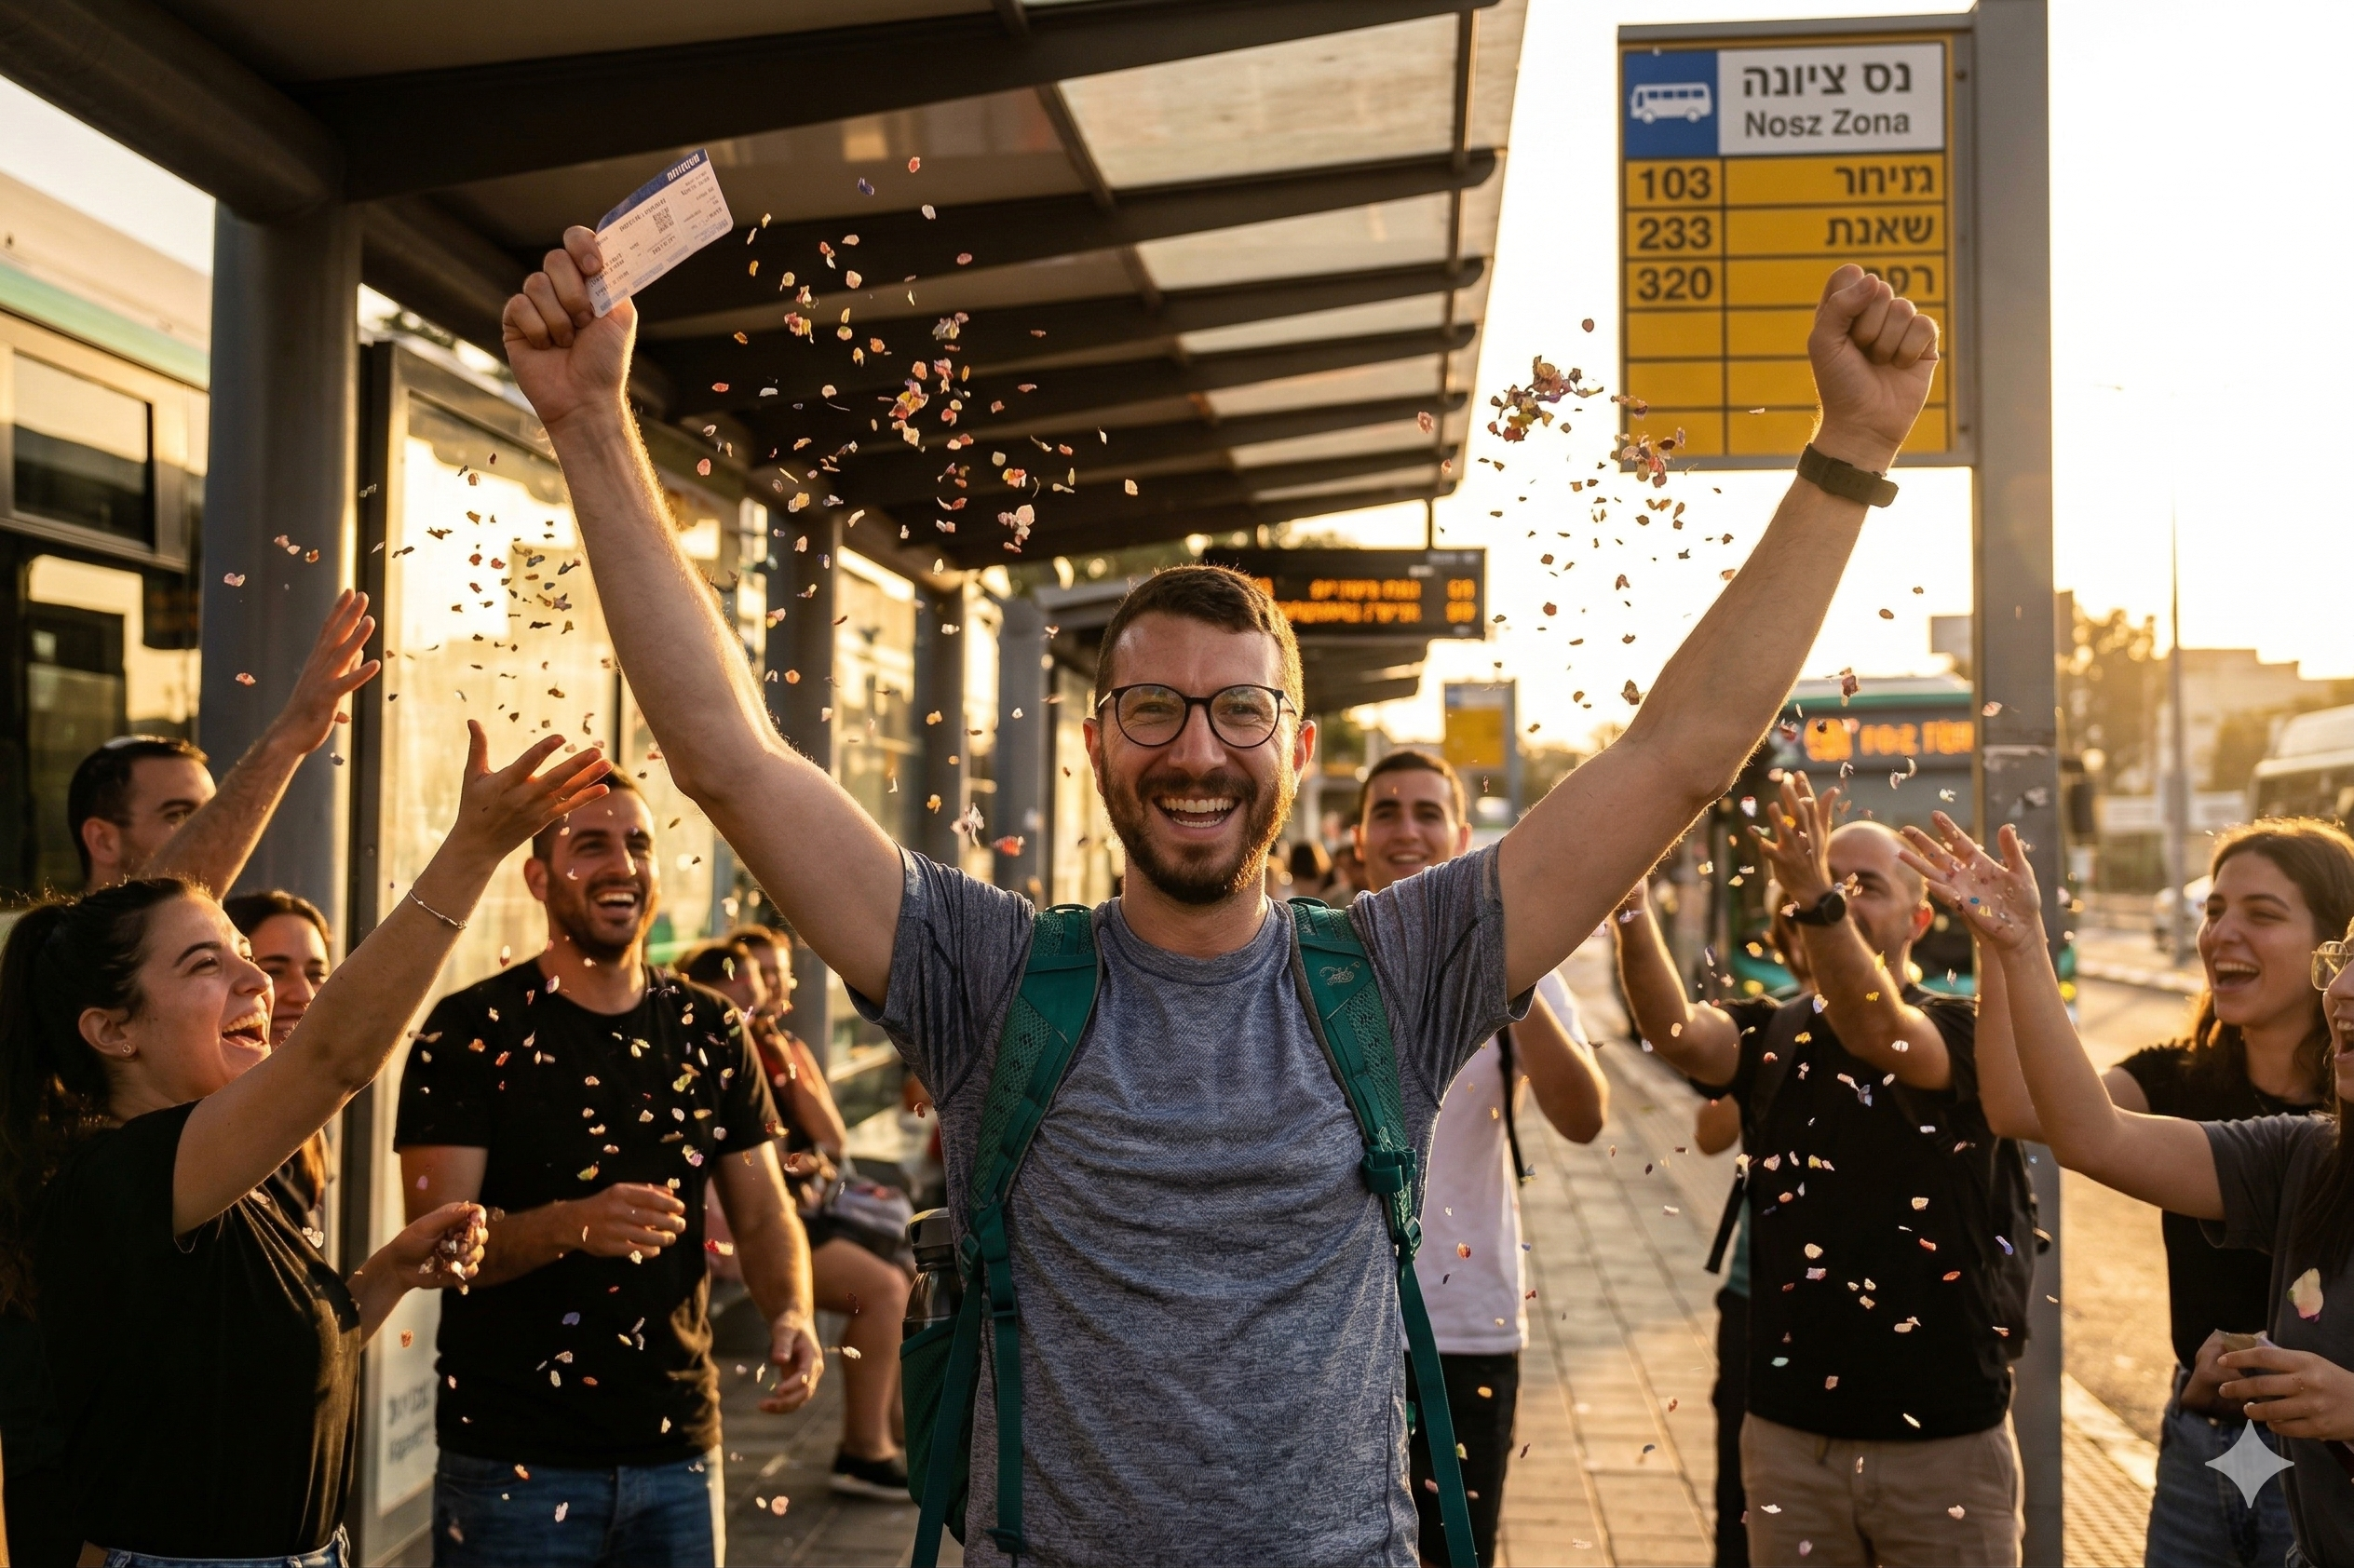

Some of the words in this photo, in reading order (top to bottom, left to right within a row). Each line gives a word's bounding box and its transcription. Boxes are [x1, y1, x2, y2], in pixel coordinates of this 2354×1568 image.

[1743, 64, 1847, 98] ציונה
[1862, 62, 1912, 94] נס
[1744, 110, 1822, 138] Nosz
[1831, 108, 1911, 136] Zona
[1639, 166, 1711, 201] 103
[1638, 217, 1711, 250] 233
[1826, 216, 1933, 247] שאנת
[1638, 267, 1712, 301] 320
